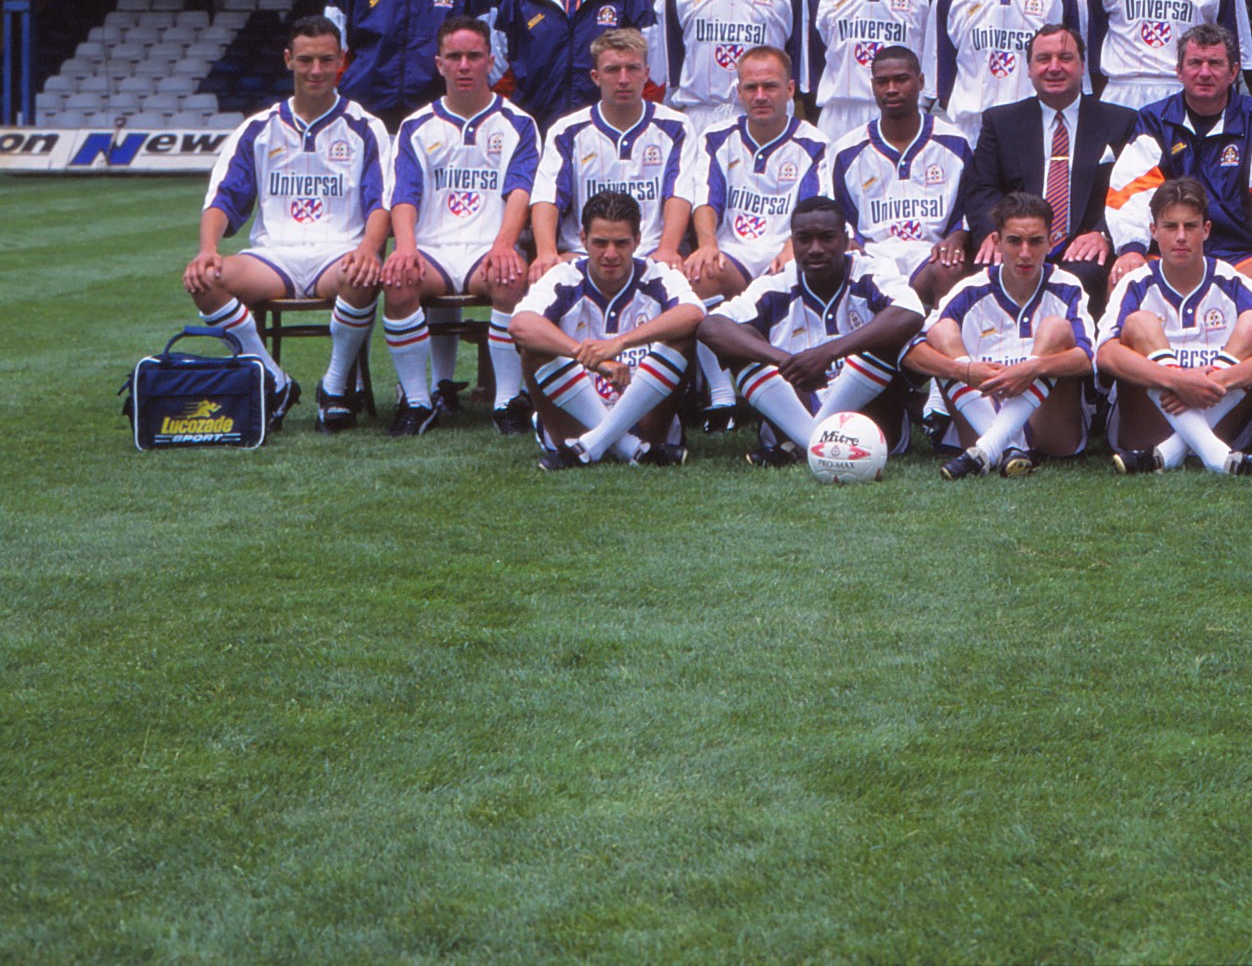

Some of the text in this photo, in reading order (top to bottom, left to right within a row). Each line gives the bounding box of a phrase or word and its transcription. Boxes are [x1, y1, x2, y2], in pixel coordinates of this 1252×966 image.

[696, 18, 767, 45] Universal
[838, 16, 907, 42] Universal
[971, 25, 1038, 51] Universa
[269, 172, 343, 197] Universal
[871, 195, 943, 224] Universal
[161, 416, 234, 434] Lucozade
[171, 434, 224, 442] SPORT
[819, 430, 859, 446] Mitre
